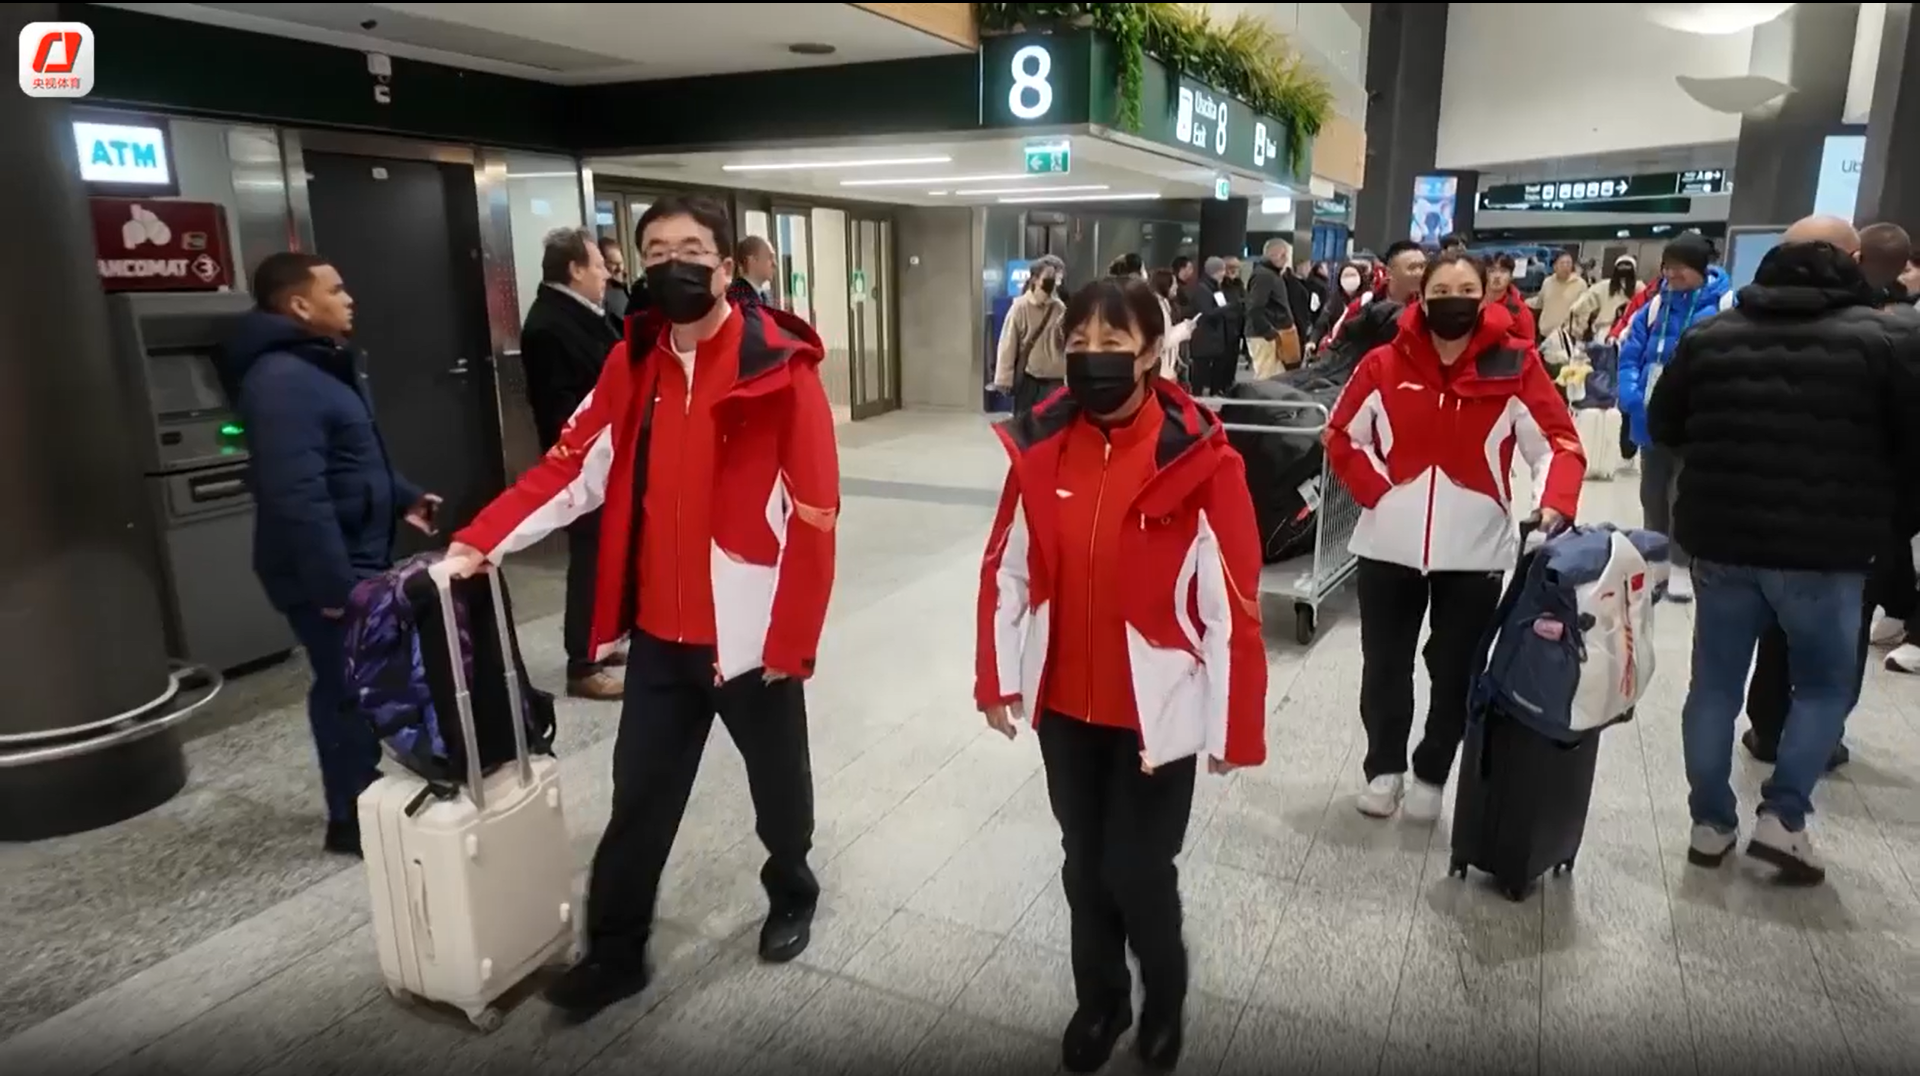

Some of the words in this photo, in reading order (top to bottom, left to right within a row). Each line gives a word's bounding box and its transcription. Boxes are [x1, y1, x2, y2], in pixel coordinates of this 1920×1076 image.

[1008, 45, 1053, 119] 8
[1215, 102, 1228, 155] 8
[91, 139, 157, 168] ATM
[1841, 159, 1861, 174] Ub
[98, 258, 189, 278] ANCOMAT
